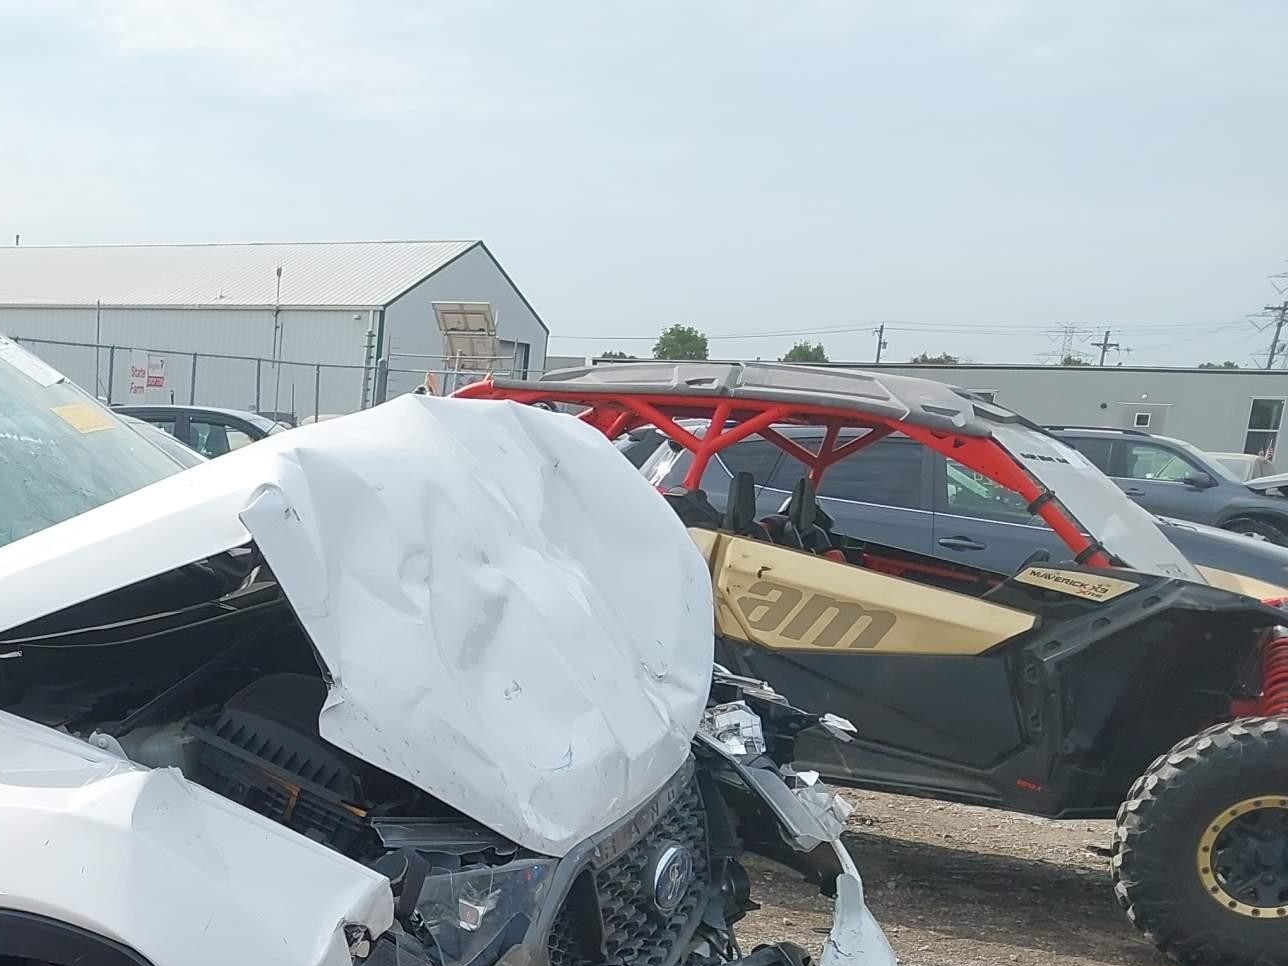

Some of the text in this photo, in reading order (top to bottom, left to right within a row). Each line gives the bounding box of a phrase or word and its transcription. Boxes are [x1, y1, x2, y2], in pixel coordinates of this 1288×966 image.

[1029, 570, 1109, 594] MAVERICK X3
[737, 581, 897, 648] am
